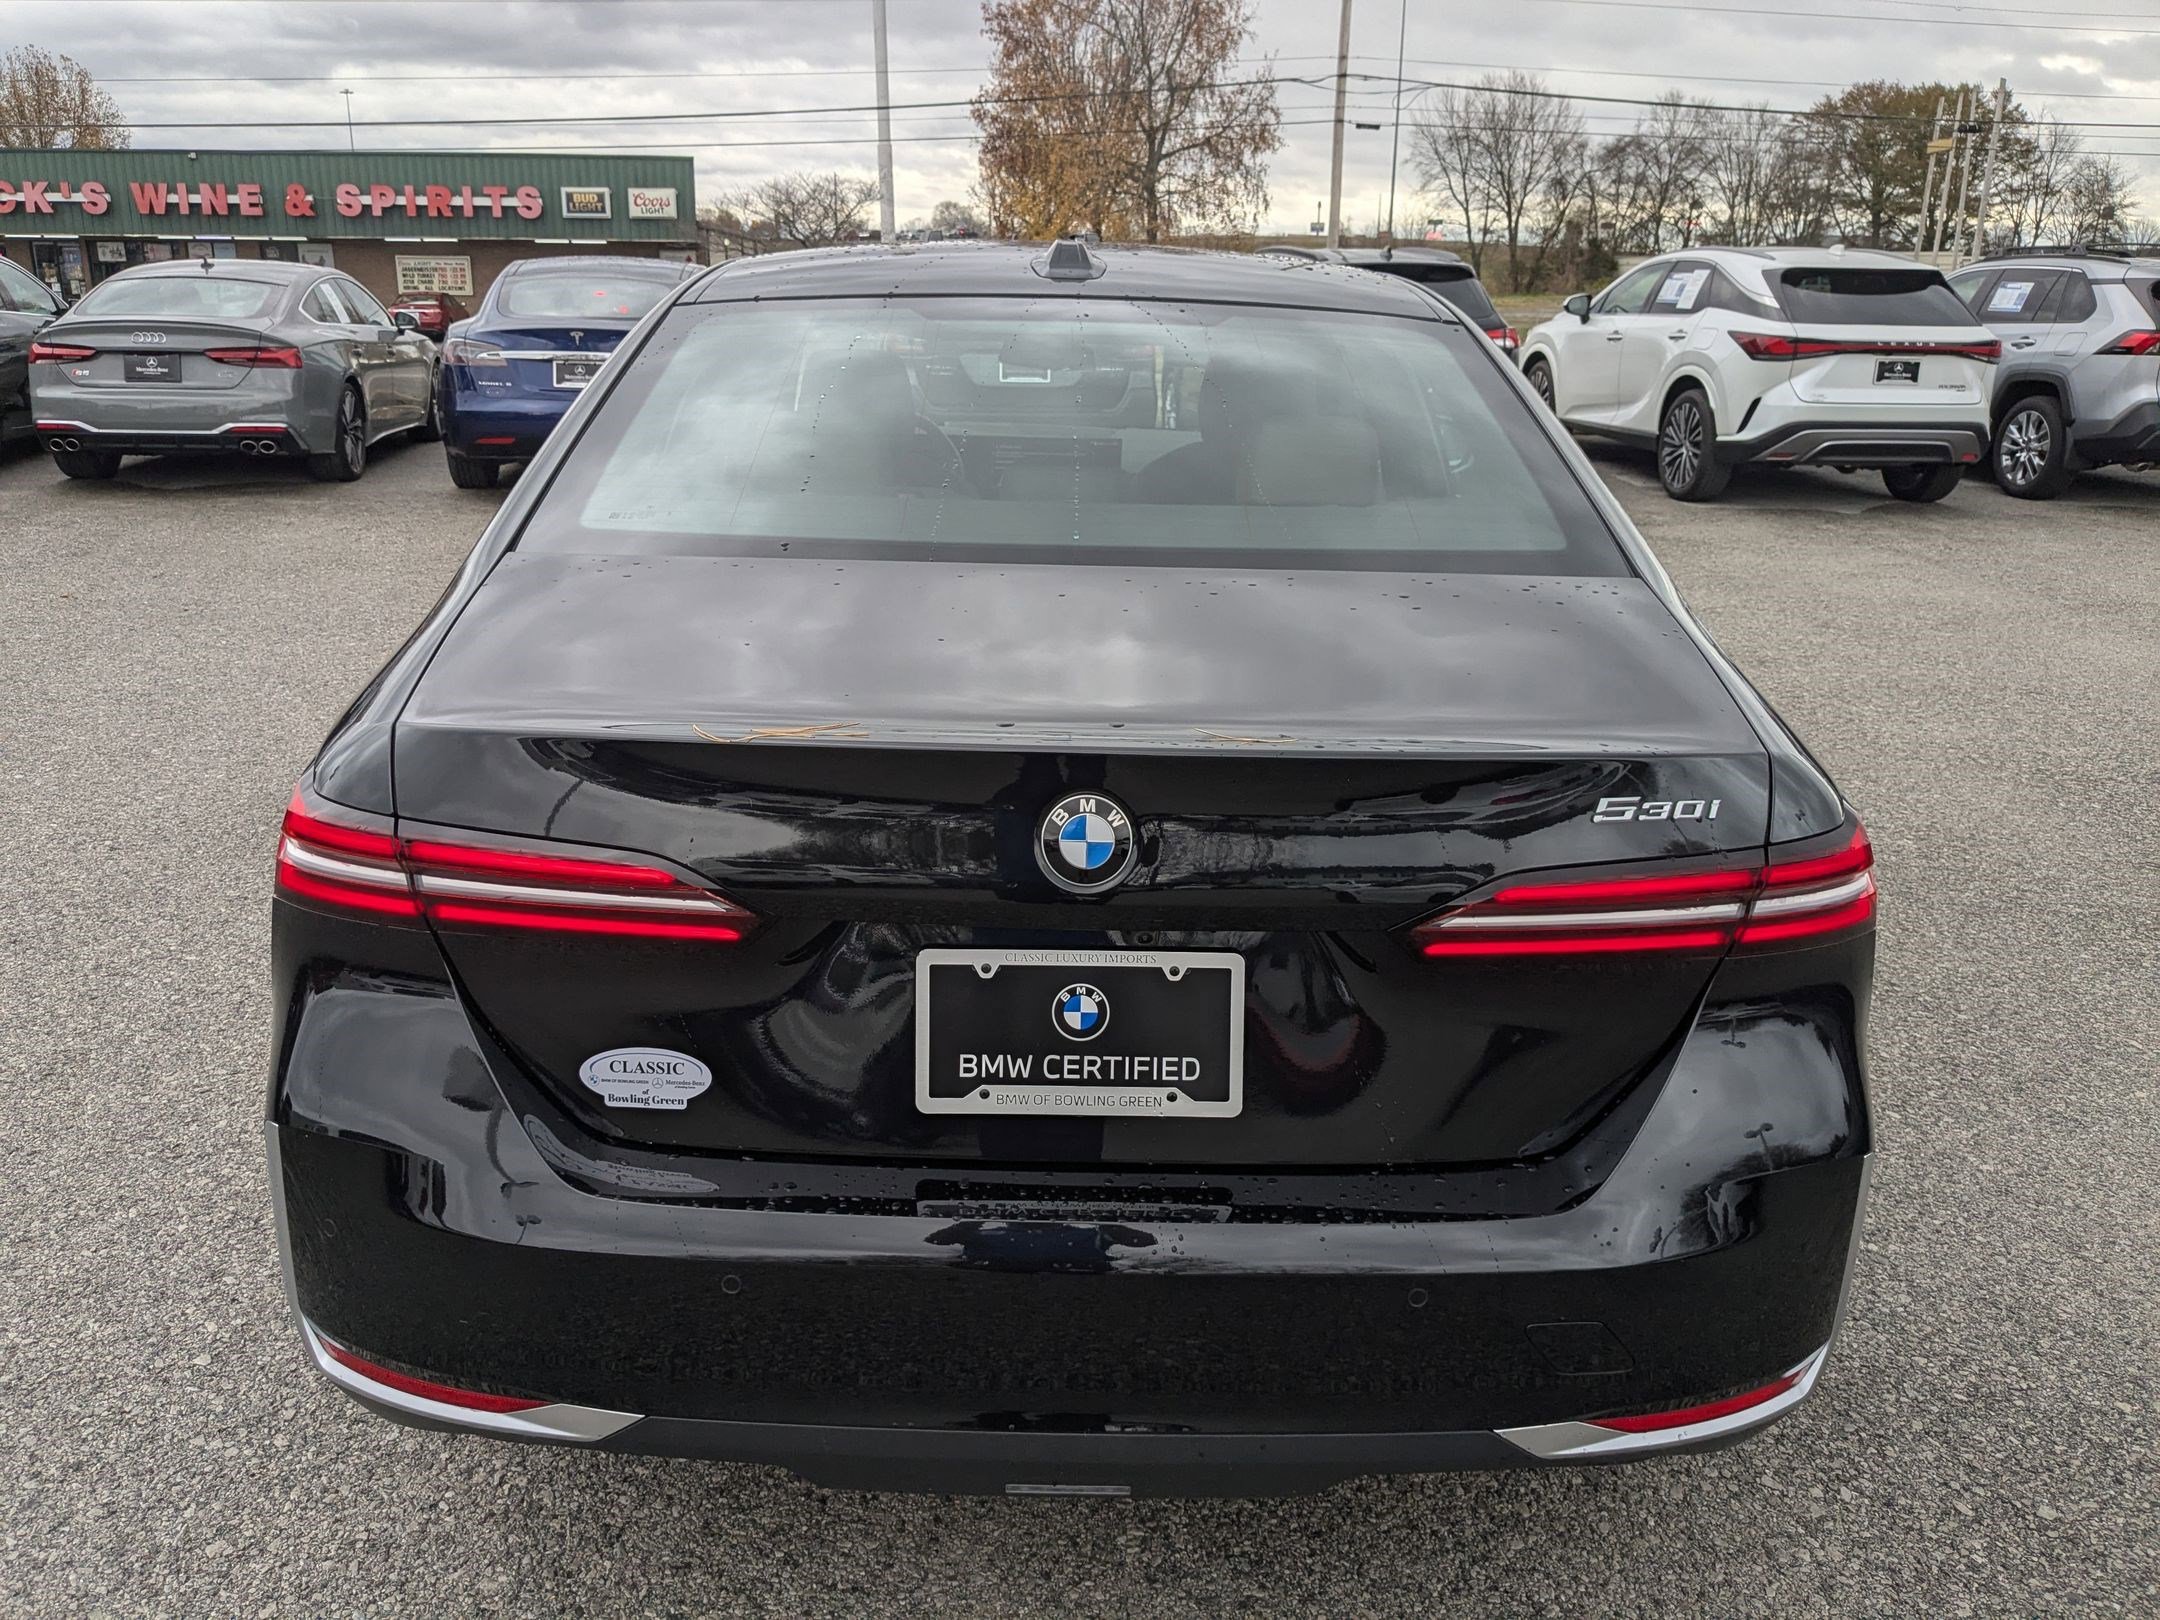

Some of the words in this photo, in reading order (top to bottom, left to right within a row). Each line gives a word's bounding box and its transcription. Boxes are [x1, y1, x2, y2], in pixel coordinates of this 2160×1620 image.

[130, 181, 264, 216] WINE
[285, 183, 316, 218] &
[336, 184, 544, 219] SPIRITS
[573, 194, 598, 203] BUD
[633, 192, 671, 208] Coors
[569, 203, 603, 212] LIGHT
[1051, 798, 1125, 828] BMW
[1592, 796, 1722, 823] 530i
[1004, 952, 1053, 963] CLASSIC
[1056, 953, 1102, 964] LUXURY
[1104, 954, 1157, 964] IMPORTS
[1060, 986, 1103, 1003] BMW
[609, 1059, 685, 1075] CLASSIC
[959, 1053, 1033, 1079] BMW
[1043, 1054, 1201, 1082] CERTIFIED
[608, 1093, 651, 1106] Bowling
[652, 1095, 684, 1105] Green
[996, 1093, 1031, 1106] BMW
[1033, 1094, 1051, 1106] OF
[1054, 1094, 1116, 1107] BOWLING
[1119, 1095, 1163, 1108] GREEN
